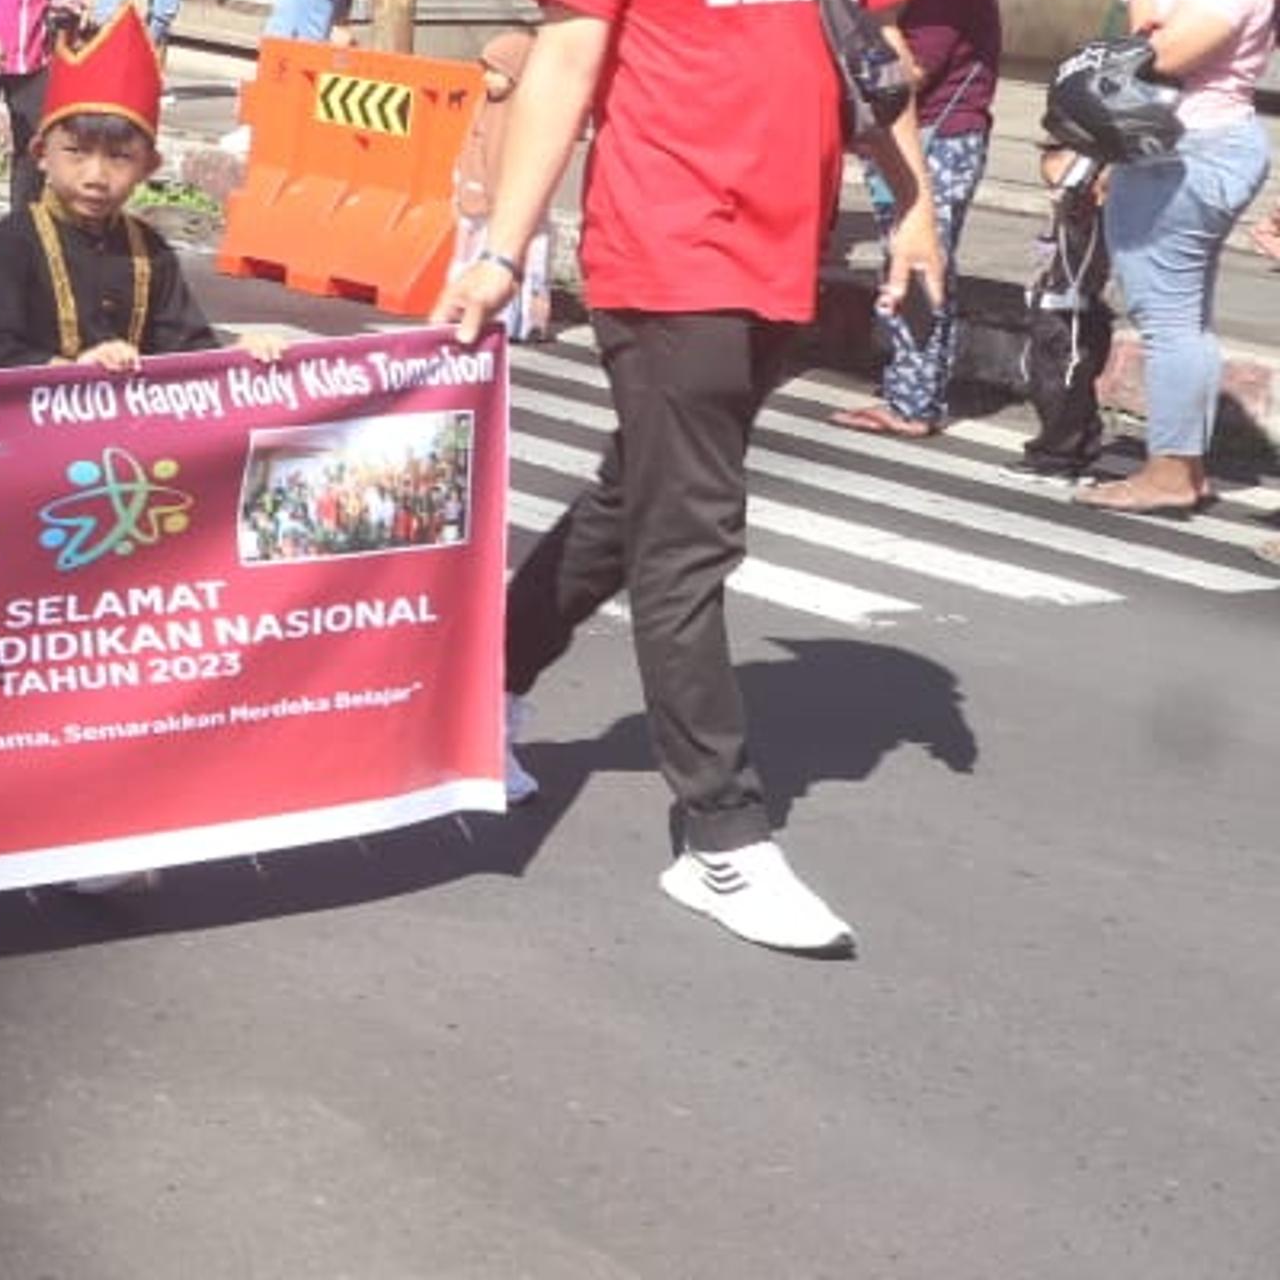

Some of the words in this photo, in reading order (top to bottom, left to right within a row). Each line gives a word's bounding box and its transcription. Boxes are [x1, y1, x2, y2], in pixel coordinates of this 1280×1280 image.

[30, 383, 118, 426] PAUD
[125, 376, 225, 420] Happy
[228, 366, 299, 410] Holy
[302, 359, 371, 399] Kids
[5, 579, 229, 628] SELAMAT
[219, 595, 438, 648] NASIONAL
[0, 663, 140, 699] TAHUN
[148, 651, 243, 683] 2023
[64, 708, 225, 745] Semarakkan
